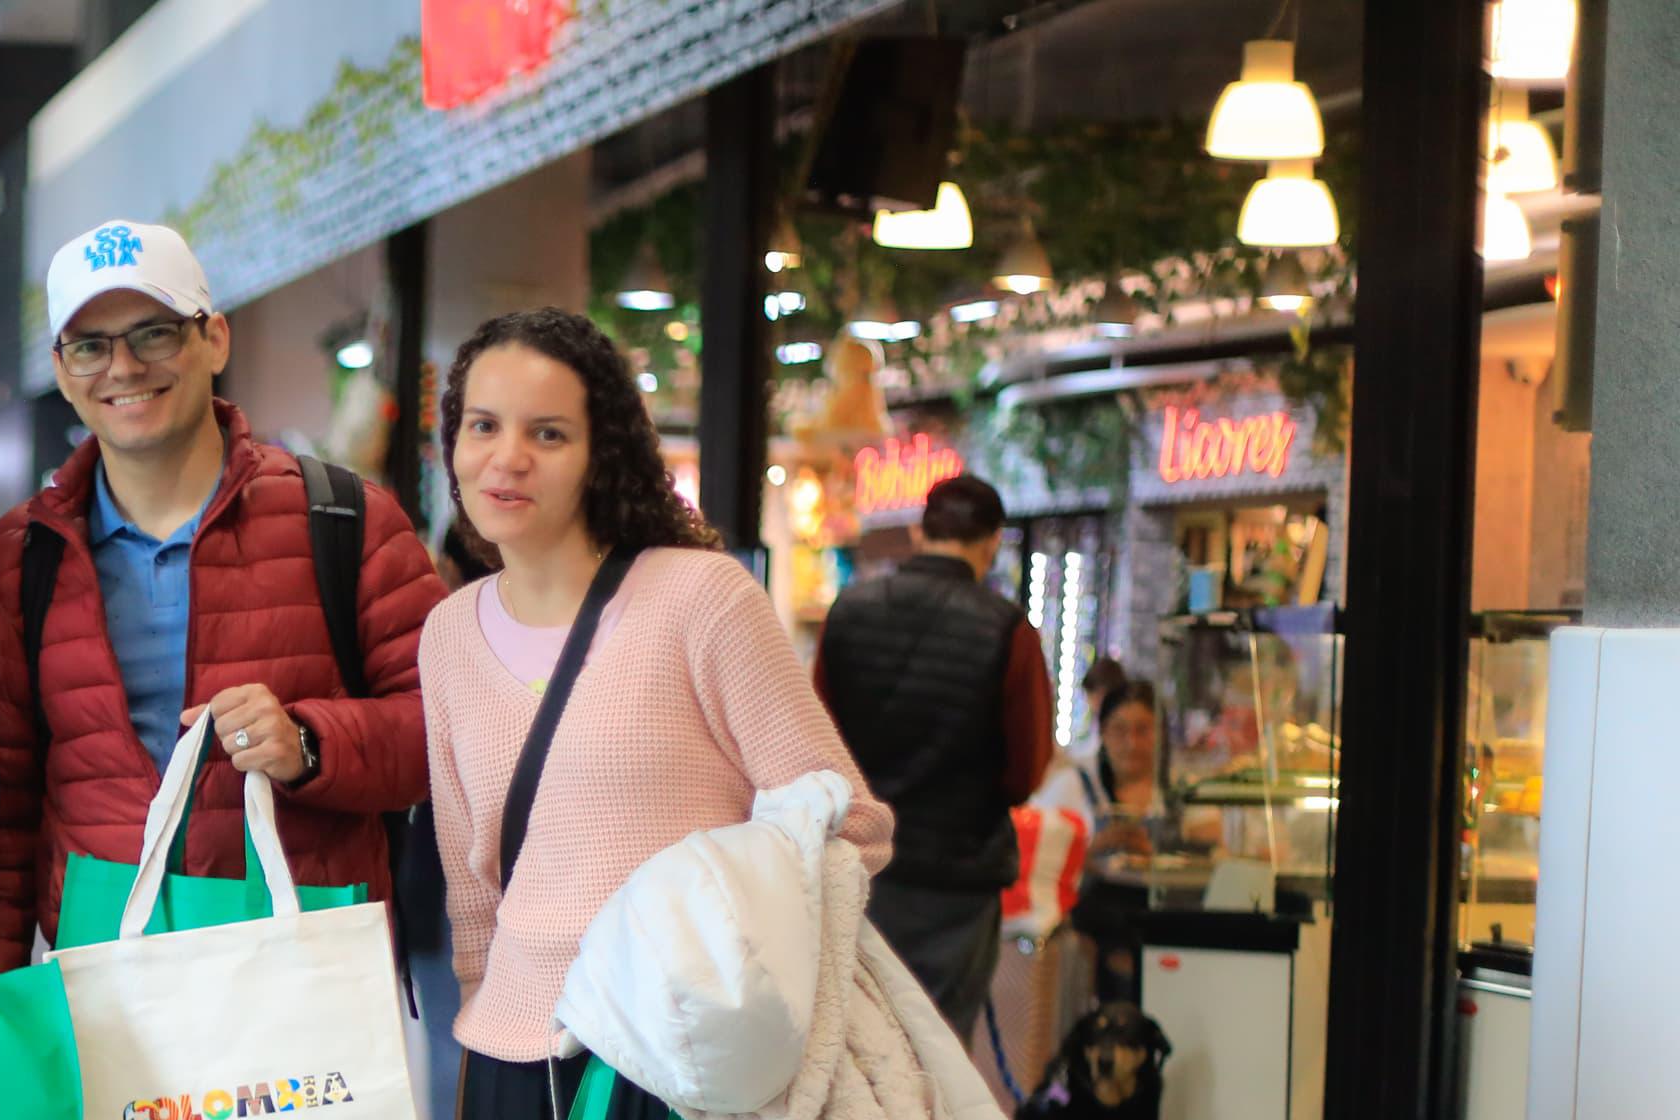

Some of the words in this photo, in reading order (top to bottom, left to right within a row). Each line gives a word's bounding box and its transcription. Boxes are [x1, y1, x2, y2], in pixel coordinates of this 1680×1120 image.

[95, 226, 131, 241] CO
[84, 237, 143, 260] LOM
[91, 250, 137, 272] BIA
